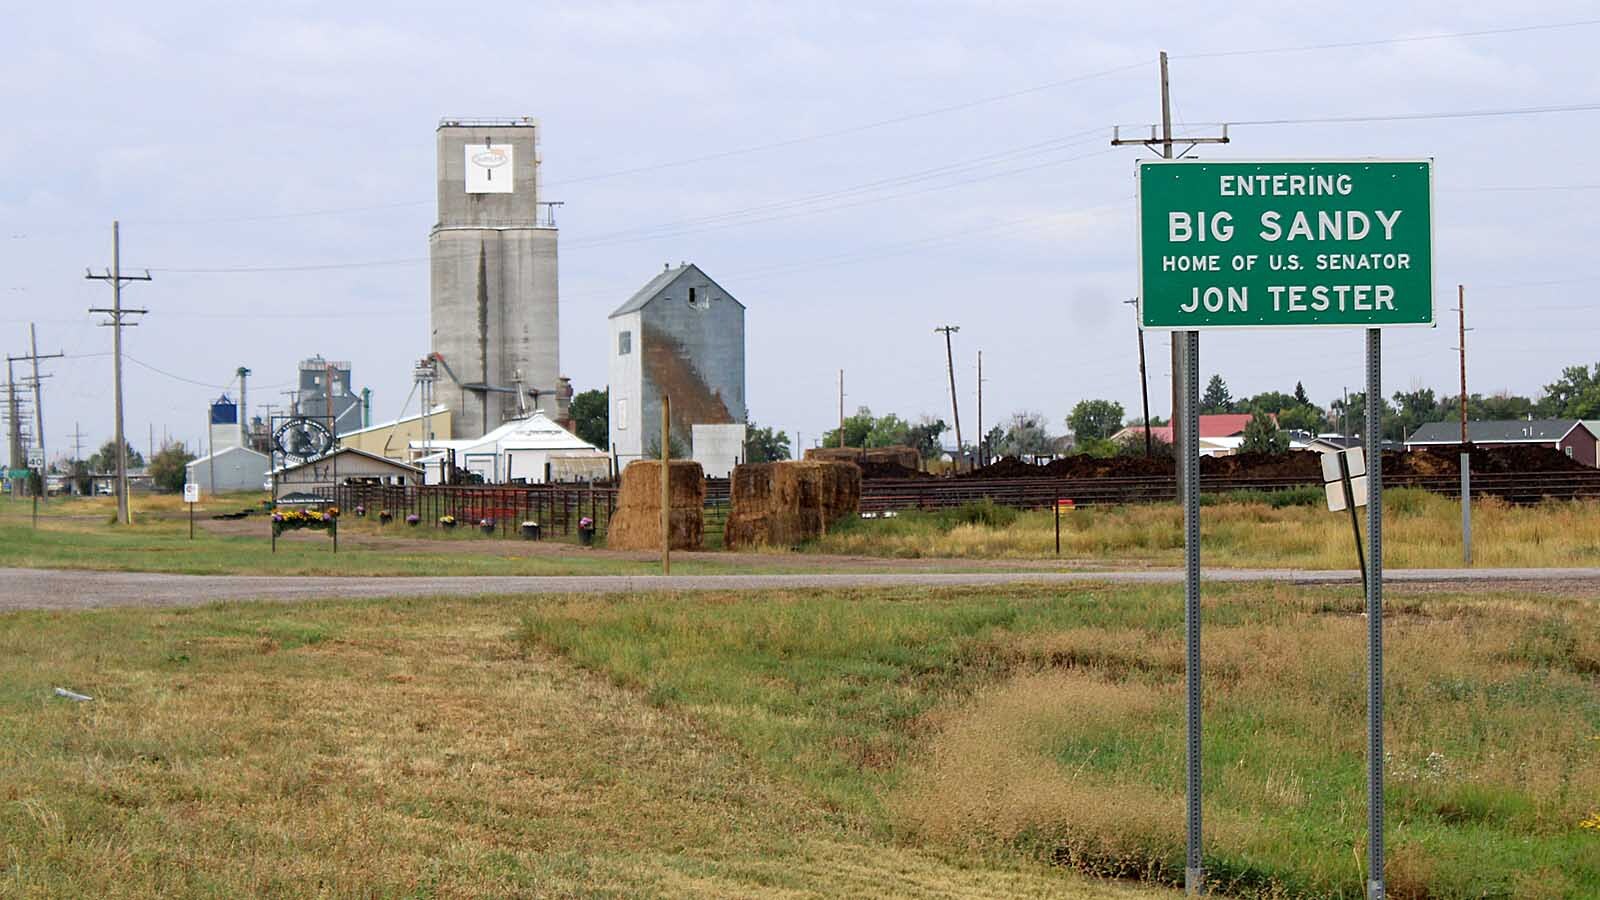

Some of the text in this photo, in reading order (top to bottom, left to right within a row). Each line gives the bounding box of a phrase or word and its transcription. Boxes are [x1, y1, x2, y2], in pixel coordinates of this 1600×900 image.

[1220, 174, 1353, 196] ENTERING
[1168, 210, 1402, 242] BIG SANDY
[1163, 253, 1411, 271] HOME OF U.S. SENATOR
[1180, 285, 1395, 313] JON TESTER
